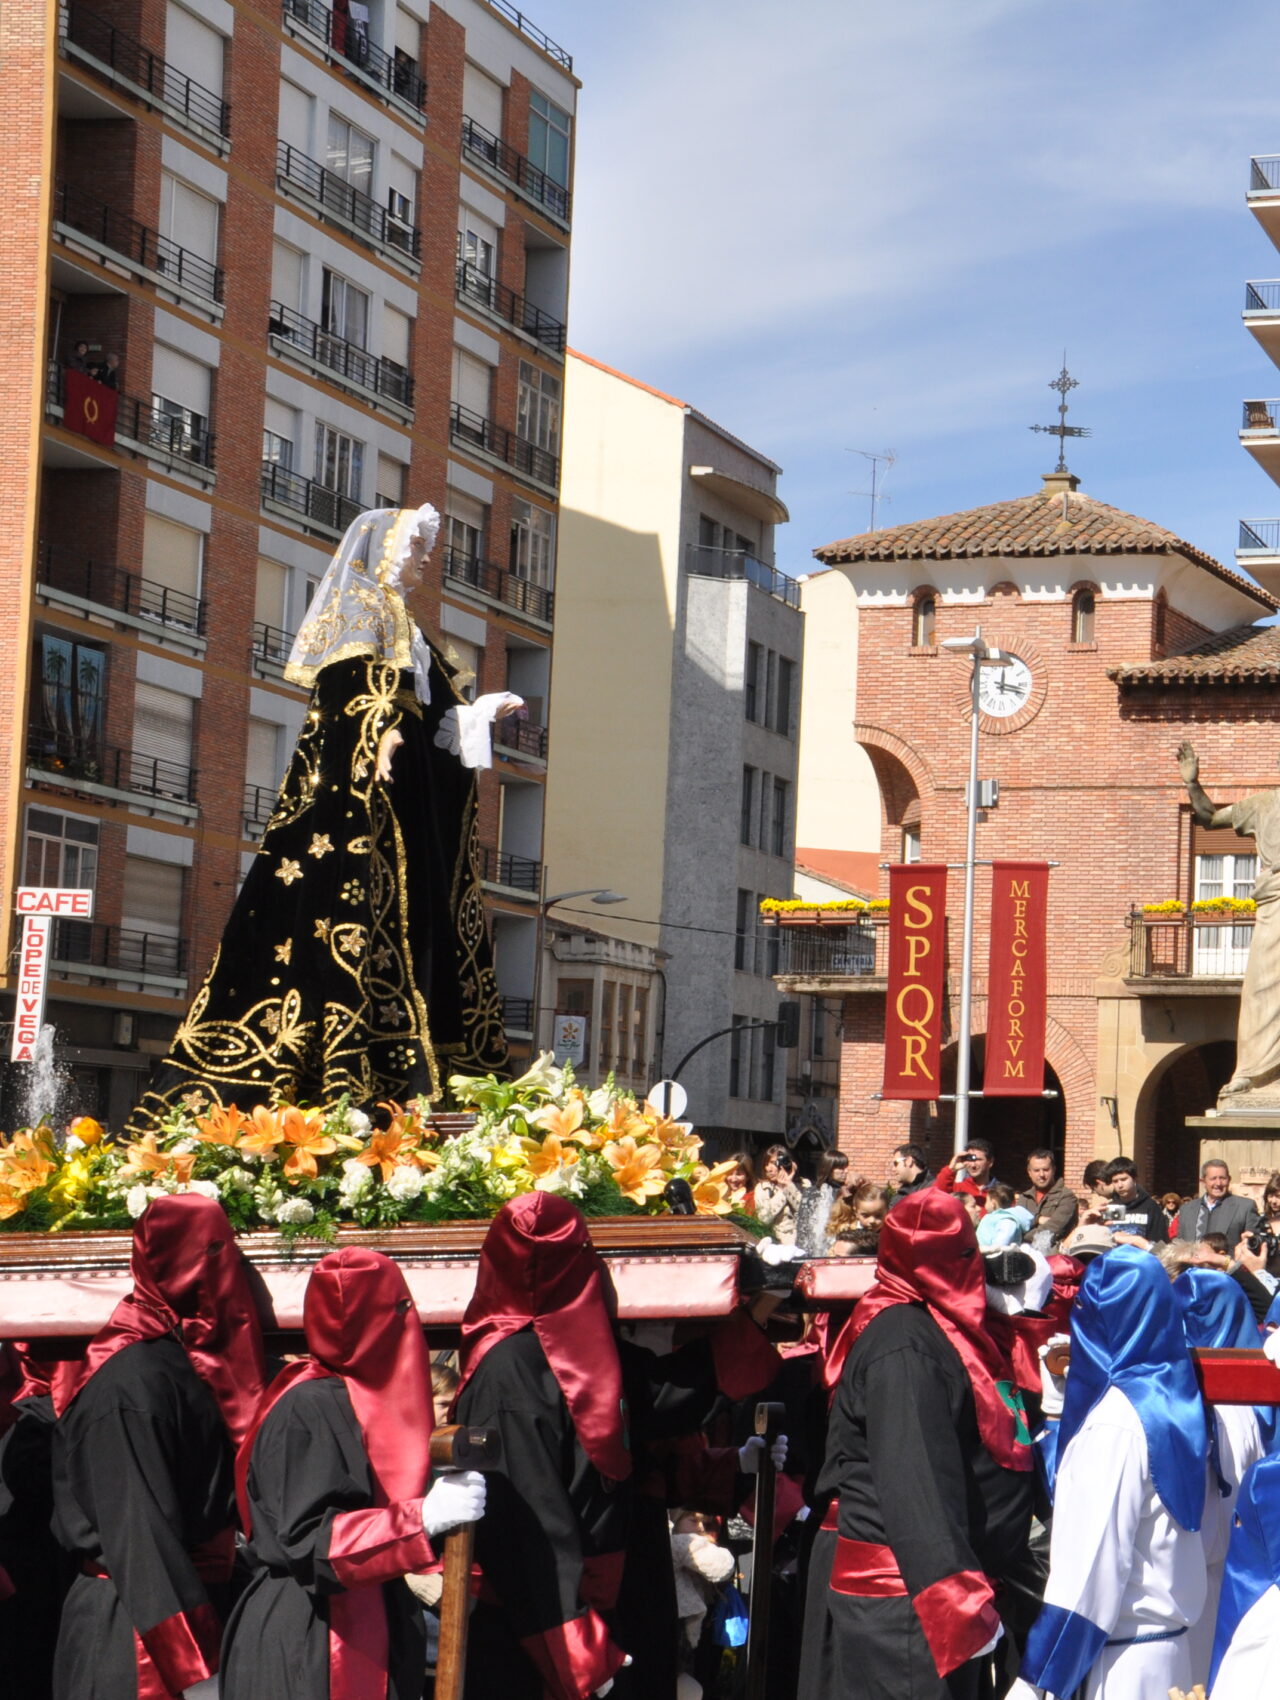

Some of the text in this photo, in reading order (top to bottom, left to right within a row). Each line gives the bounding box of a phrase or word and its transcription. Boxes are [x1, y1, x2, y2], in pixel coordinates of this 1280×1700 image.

[17, 891, 90, 913] CAFE
[896, 886, 935, 1080] SPQR
[1003, 880, 1031, 1078] MERCAFORVM
[16, 919, 44, 1060] LOPE DE VEGA
